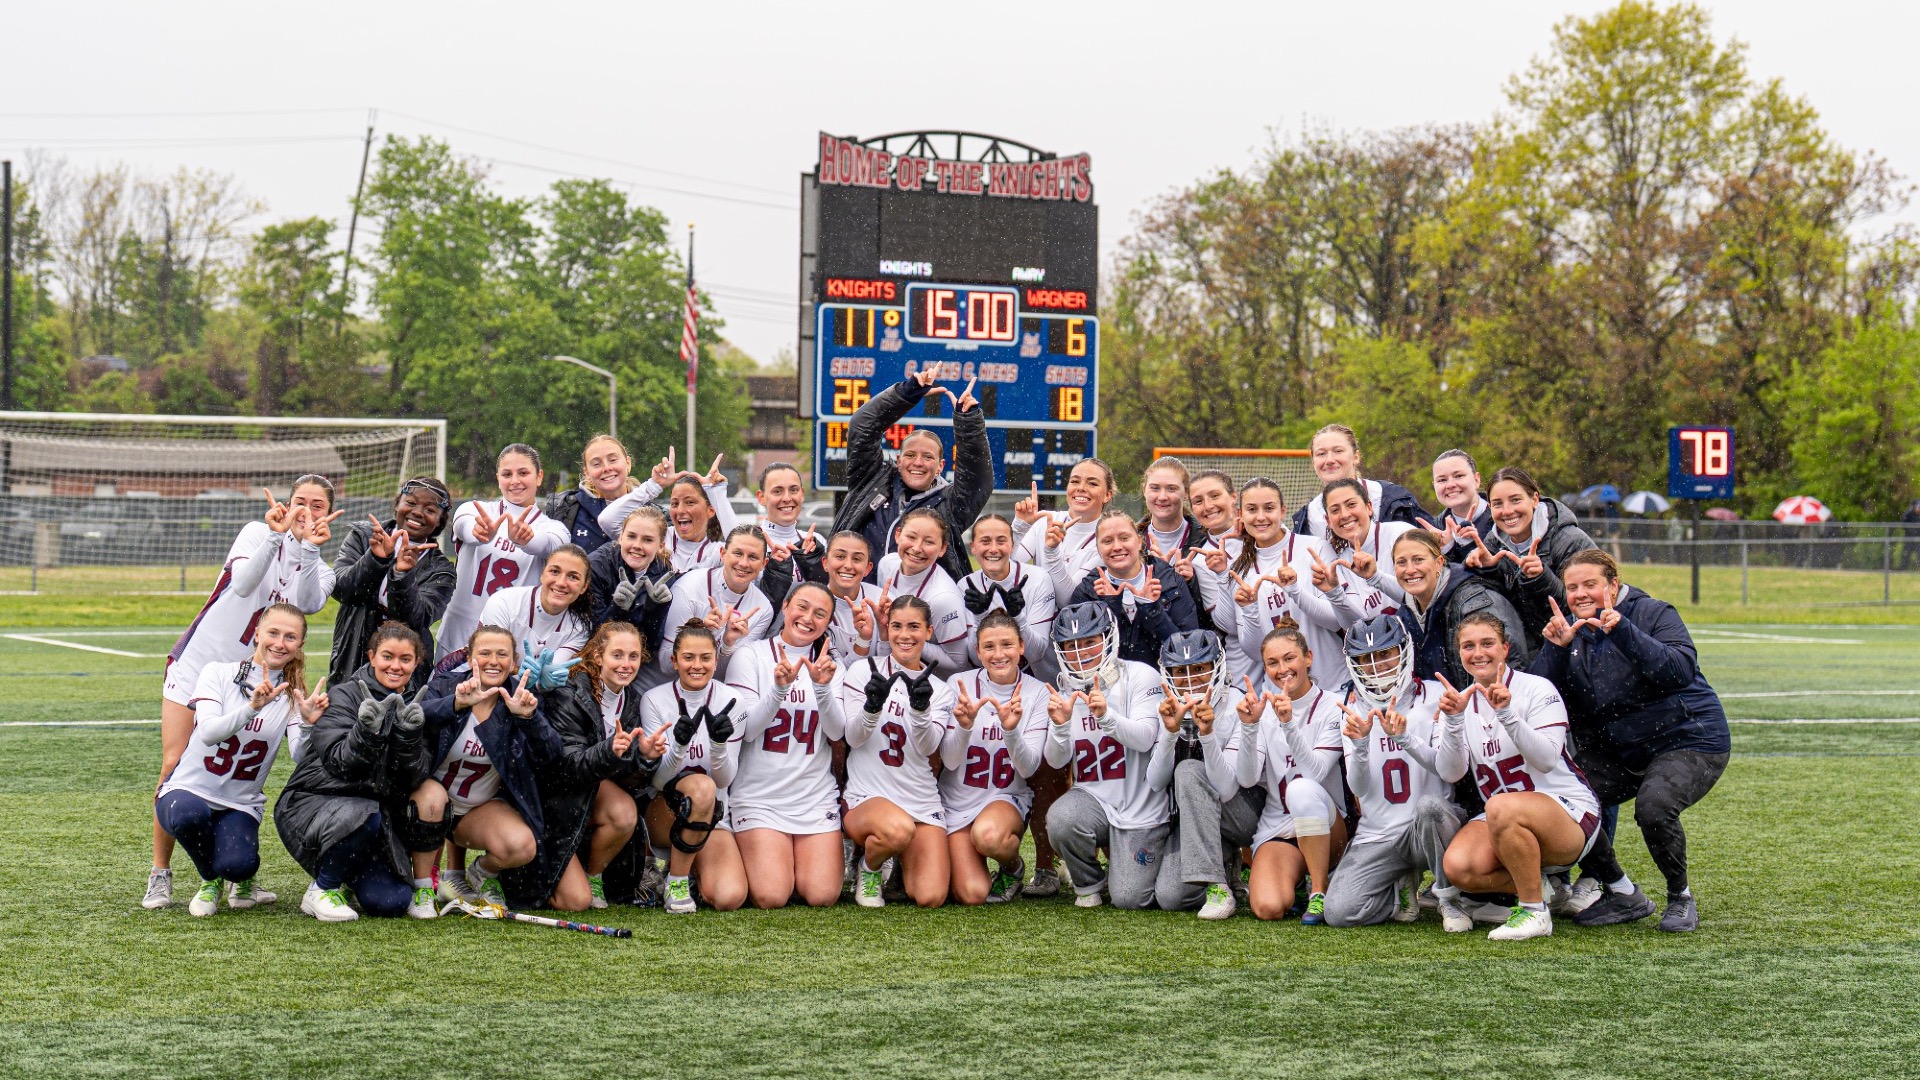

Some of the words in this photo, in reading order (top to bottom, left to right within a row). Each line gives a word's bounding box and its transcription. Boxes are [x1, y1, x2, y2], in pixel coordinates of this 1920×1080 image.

[819, 133, 891, 188] HOME
[896, 154, 929, 191] OF
[934, 159, 983, 195] THE
[987, 152, 1092, 202] KNIGHTS
[826, 278, 896, 299] KNIGHTS
[879, 260, 933, 276] KNIGHTS
[926, 289, 1014, 341] 15:00
[1026, 289, 1088, 309] WAGNER
[846, 307, 875, 348] 11
[1066, 317, 1087, 357] 6
[830, 357, 876, 377] SHOTS
[1045, 365, 1088, 386] SHOTS
[1058, 387, 1083, 421] 18
[1679, 431, 1728, 476] 78
[471, 553, 520, 597] 18
[761, 708, 819, 755] 24
[879, 720, 907, 768] 3
[203, 734, 269, 782] 32
[442, 759, 492, 799] 17
[963, 745, 1015, 790] 26
[1075, 735, 1127, 783] 22
[1476, 754, 1536, 801] 25
[1382, 758, 1411, 805] 0
